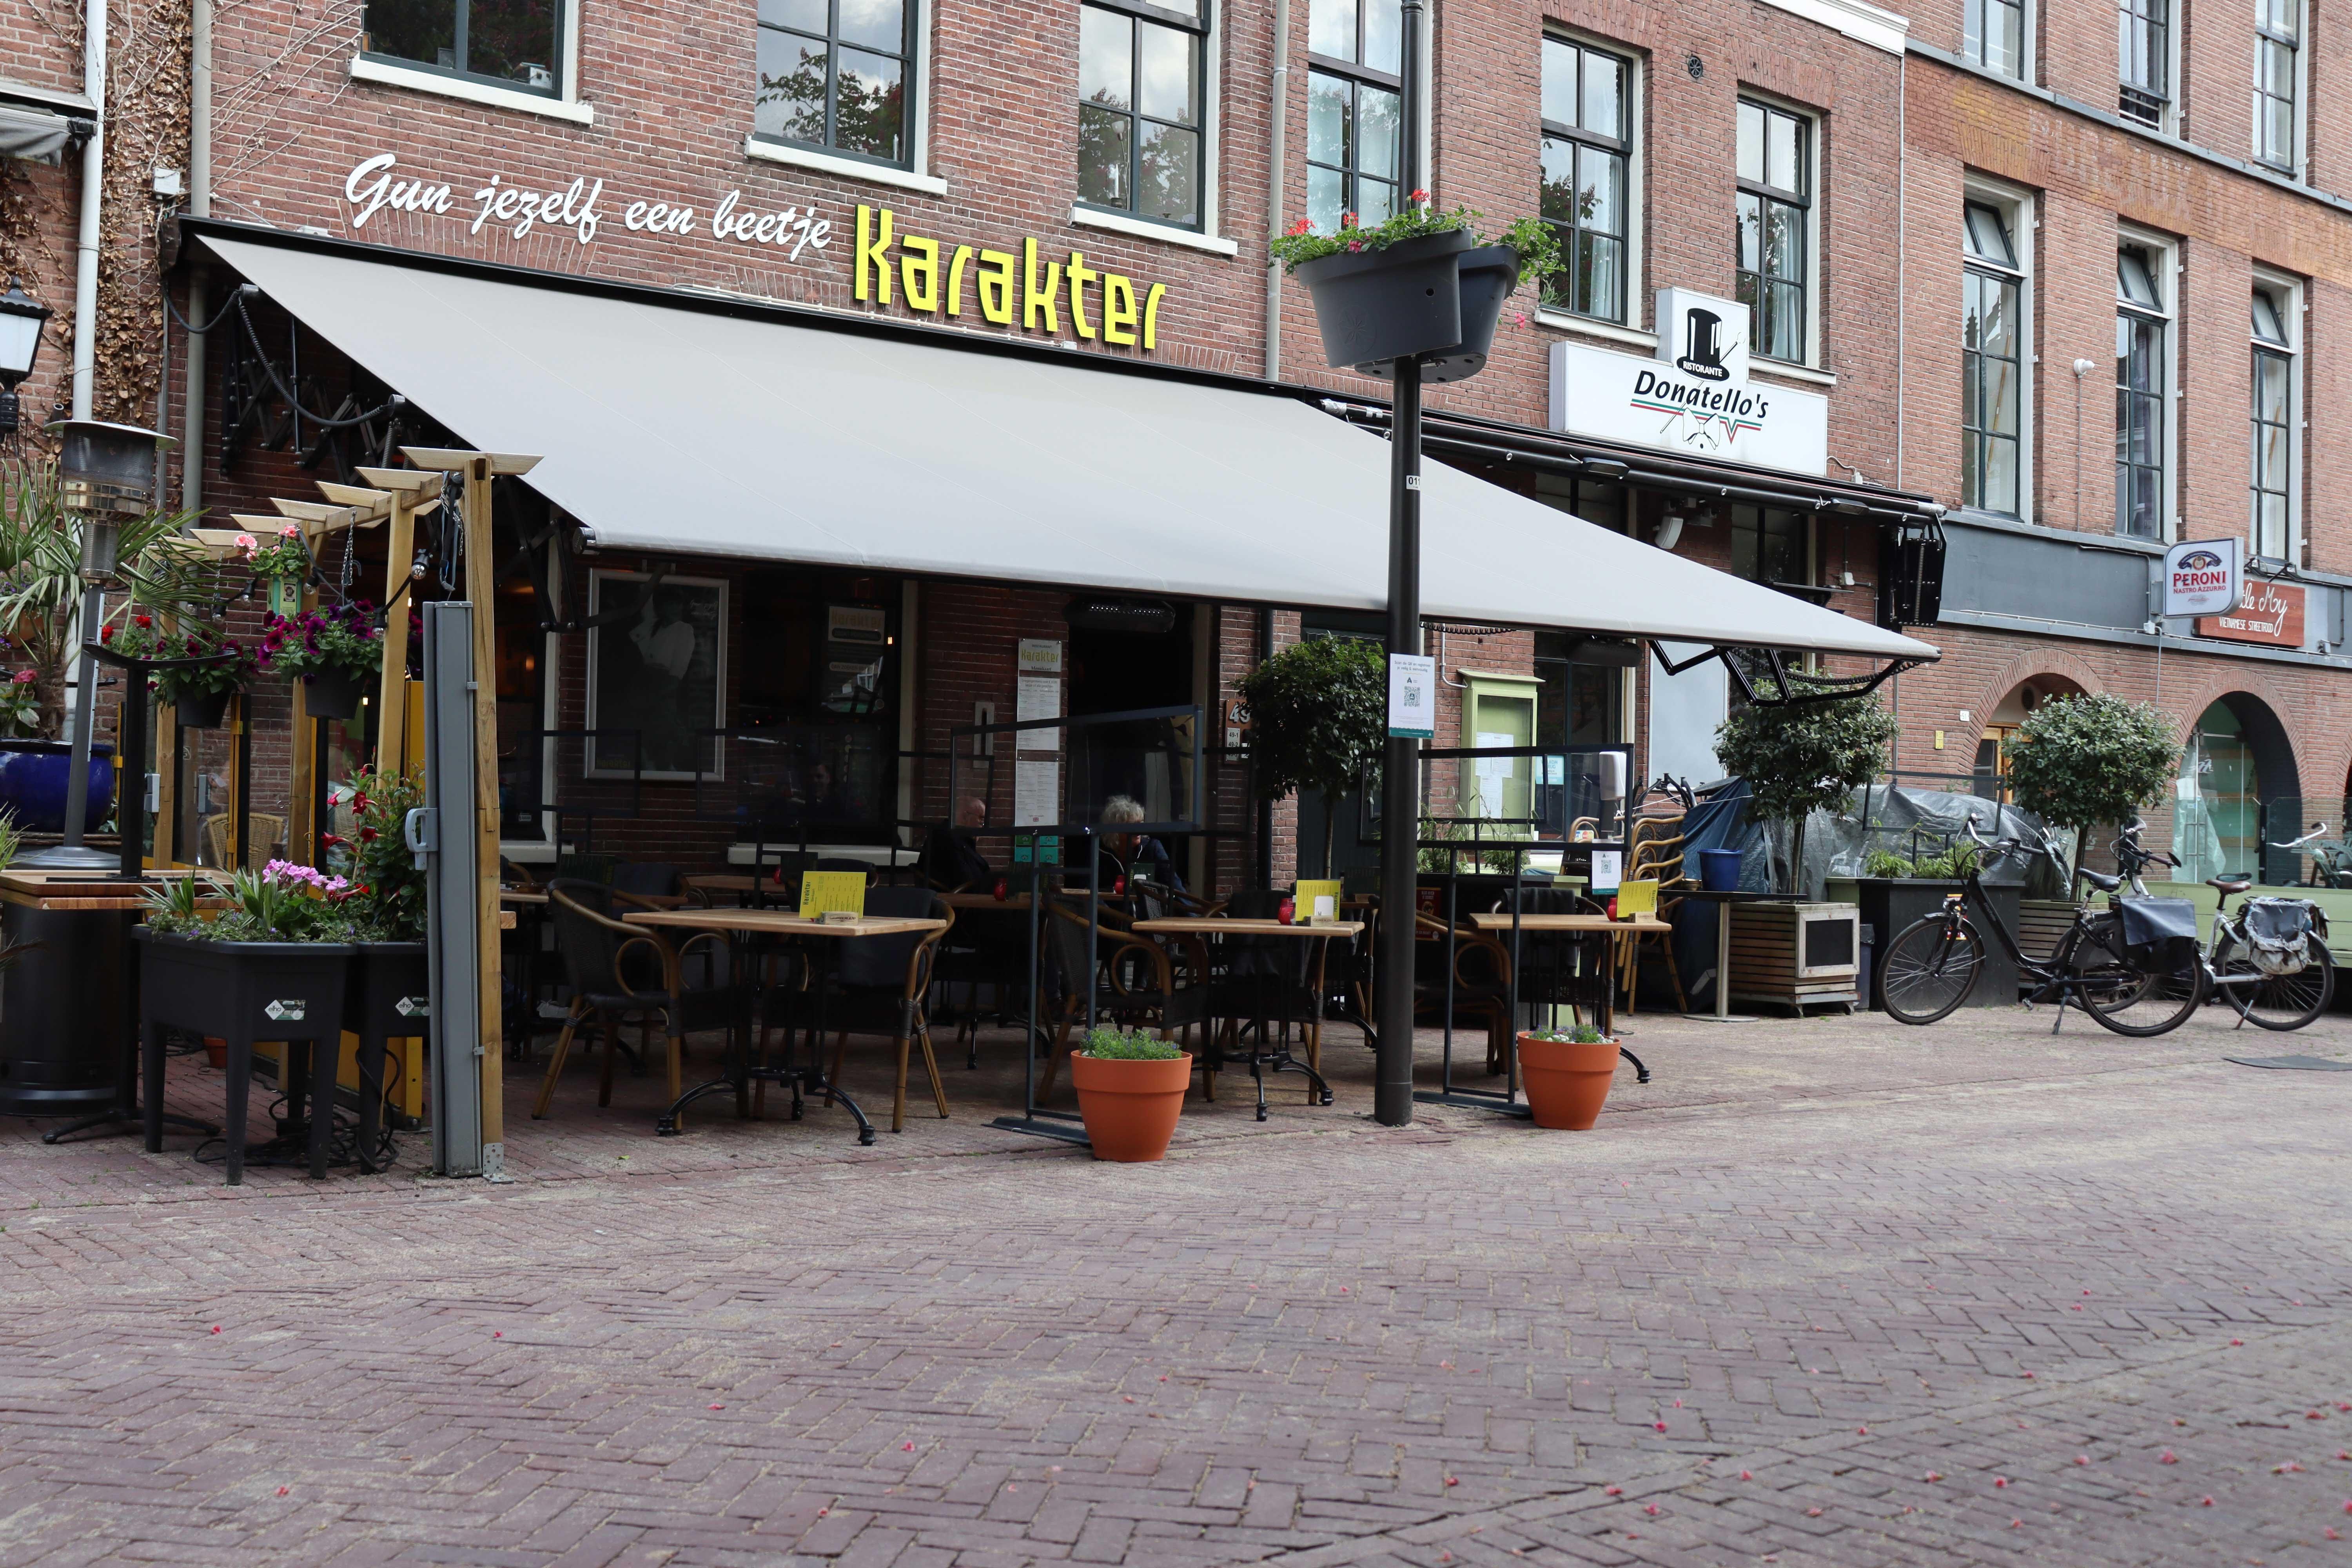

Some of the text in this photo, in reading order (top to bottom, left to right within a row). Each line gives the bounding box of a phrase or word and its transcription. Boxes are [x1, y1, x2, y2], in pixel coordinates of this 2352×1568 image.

[345, 153, 832, 262] Gun jezelf een beetje
[854, 205, 1166, 350] Karakter
[1682, 361, 1723, 377] RISTORANTE
[1634, 370, 1769, 419] Donatello's
[2173, 571, 2227, 587] PERONI
[2259, 586, 2288, 637] My
[2219, 617, 2274, 633] VIETNAMESE STREETFOOD
[1021, 649, 1059, 662] Karakter
[1229, 702, 1250, 723] 49
[803, 881, 811, 905] Karakter
